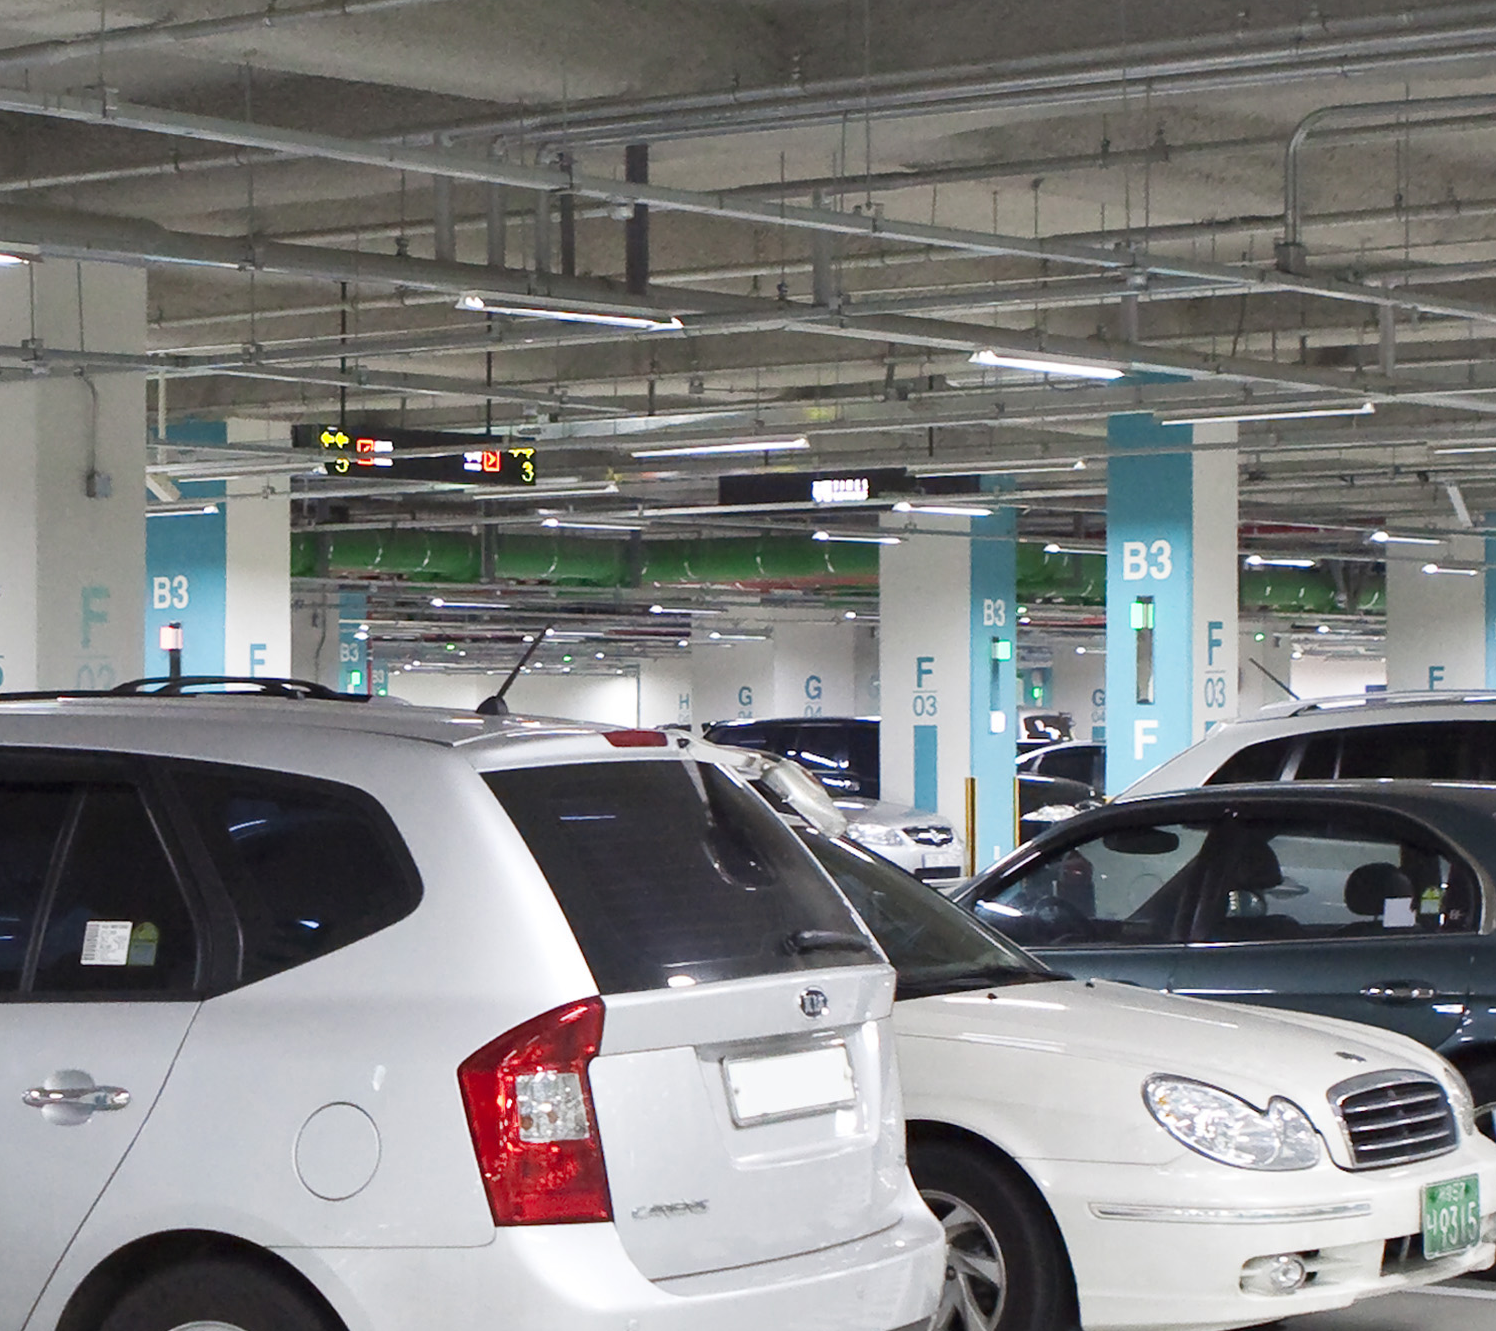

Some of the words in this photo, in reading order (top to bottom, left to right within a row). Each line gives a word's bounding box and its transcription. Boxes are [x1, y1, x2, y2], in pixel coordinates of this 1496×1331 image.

[1123, 539, 1173, 581] B3
[153, 575, 189, 609] B3
[81, 585, 111, 649] F
[983, 598, 1006, 627] B3
[339, 642, 359, 663] B3
[1208, 620, 1223, 666] F
[249, 643, 267, 677] F
[916, 655, 935, 688] F
[805, 674, 823, 700] G
[1205, 676, 1226, 709] 03
[1428, 665, 1445, 691] F
[679, 692, 691, 711] H
[738, 686, 753, 706] G
[912, 694, 938, 717] 03
[1092, 688, 1105, 707] G
[1134, 720, 1159, 761] F
